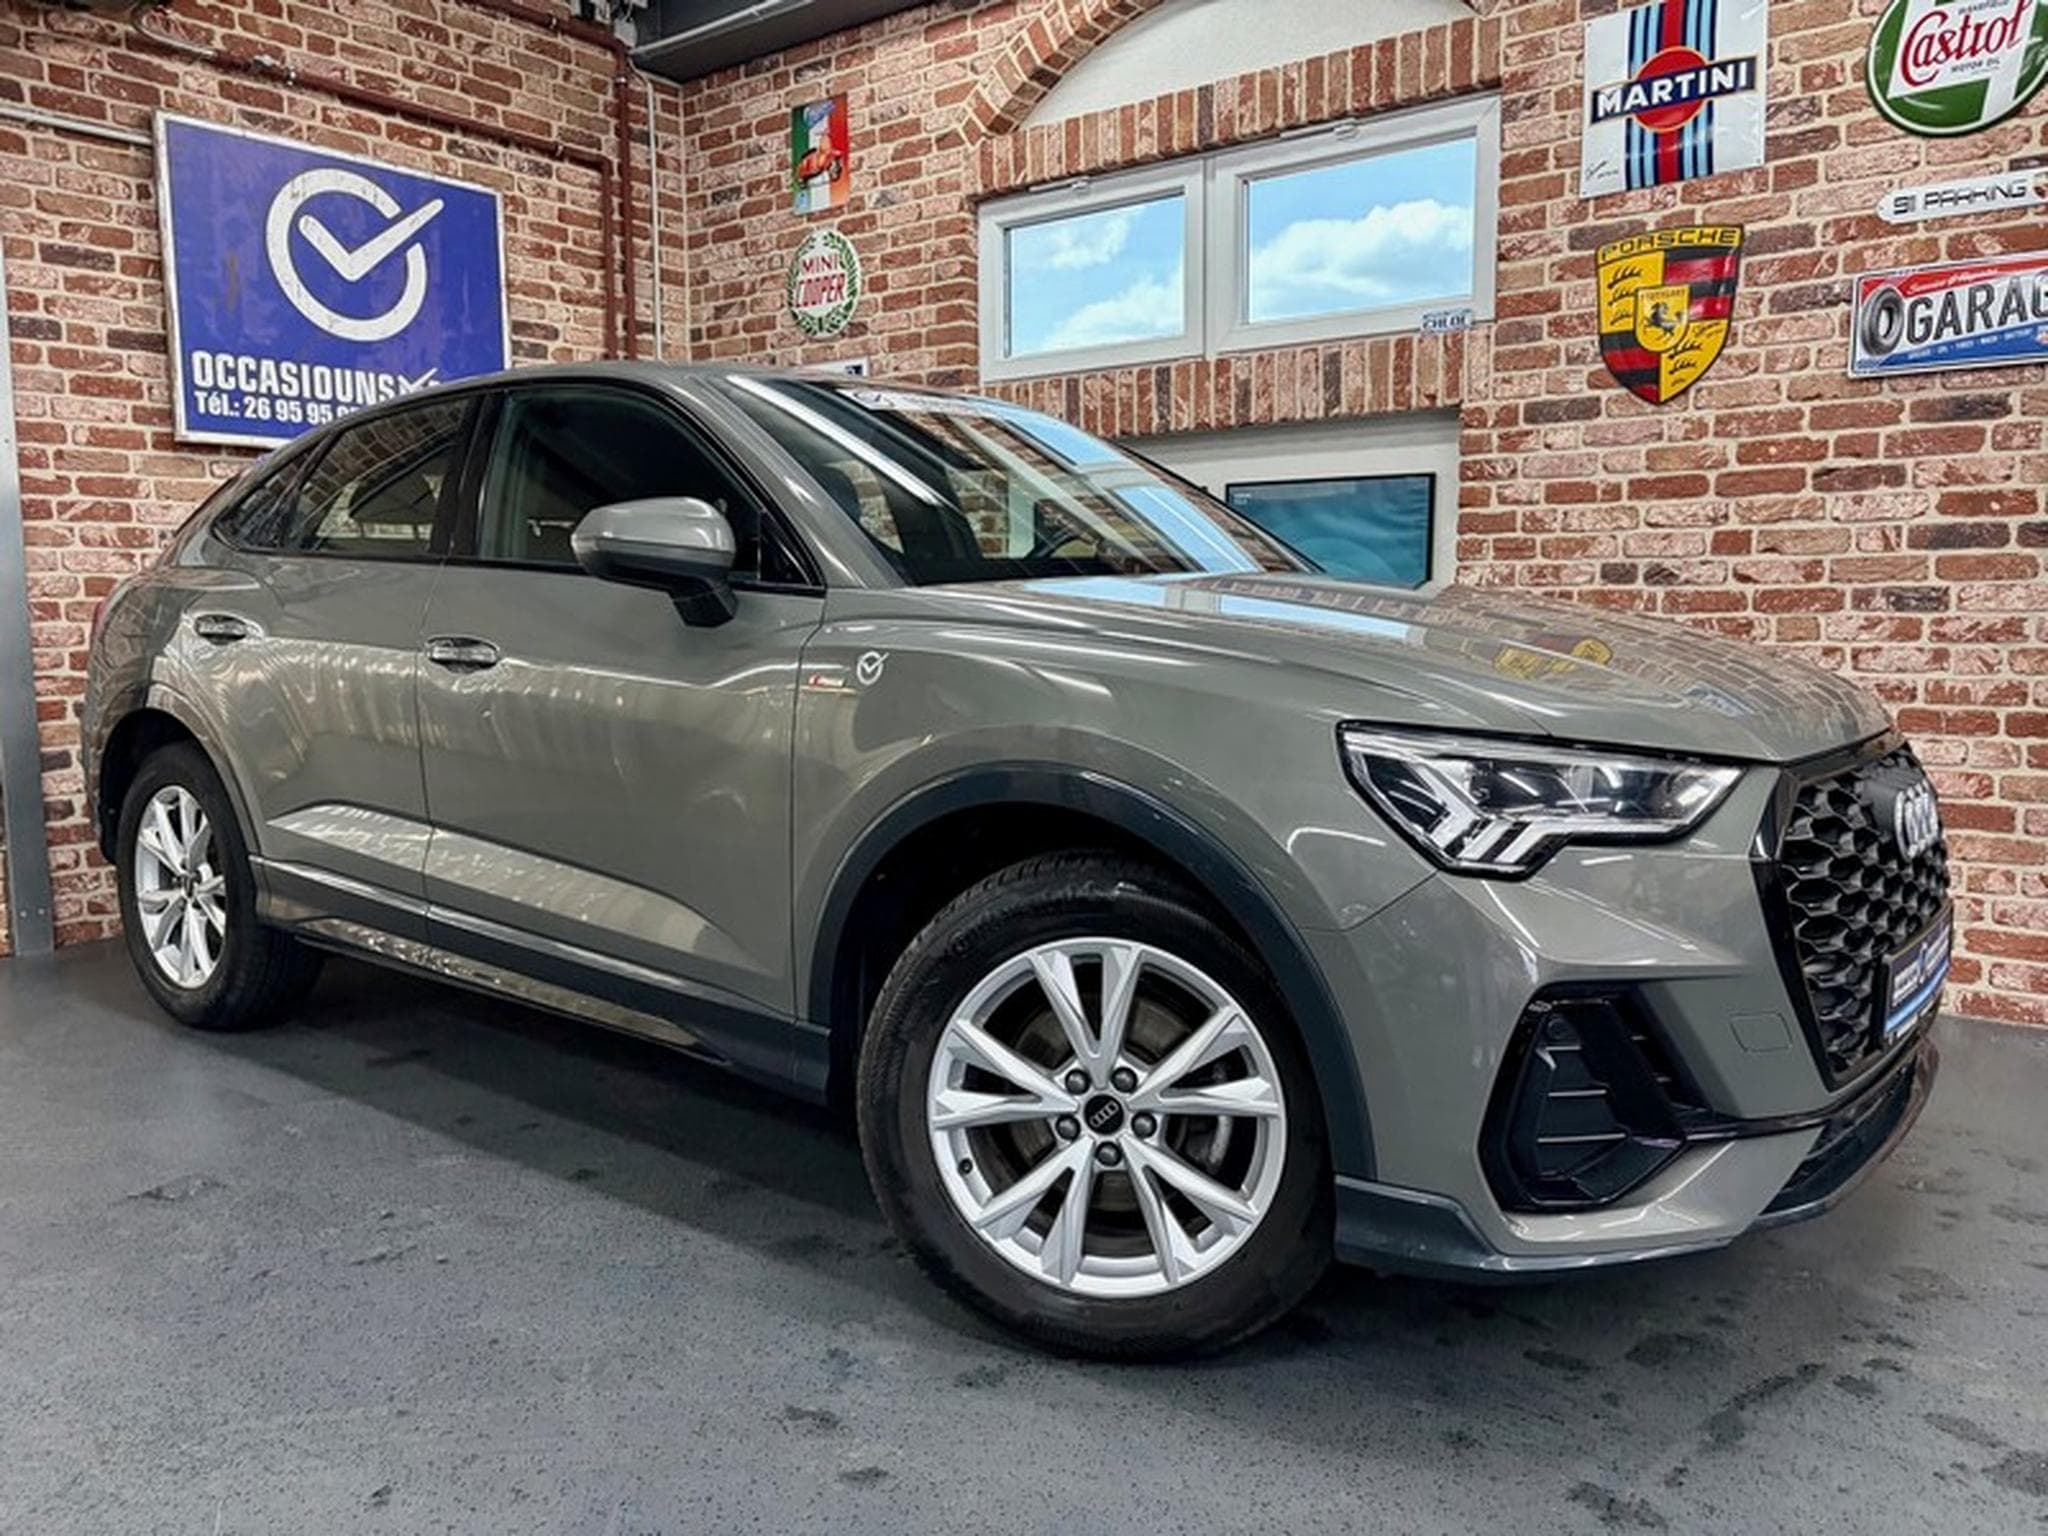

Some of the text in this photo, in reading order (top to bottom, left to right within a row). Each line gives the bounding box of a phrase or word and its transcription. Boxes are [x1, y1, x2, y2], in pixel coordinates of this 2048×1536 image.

[1901, 0, 2033, 87] Castrol
[1597, 61, 1748, 117] MARTINI
[1924, 178, 2028, 210] PARKING
[1601, 229, 1737, 261] PORSCHE
[801, 253, 838, 275] MINI
[795, 273, 845, 308] COOPER
[243, 396, 272, 421] 26
[275, 399, 303, 424] 95
[306, 402, 334, 426] 95
